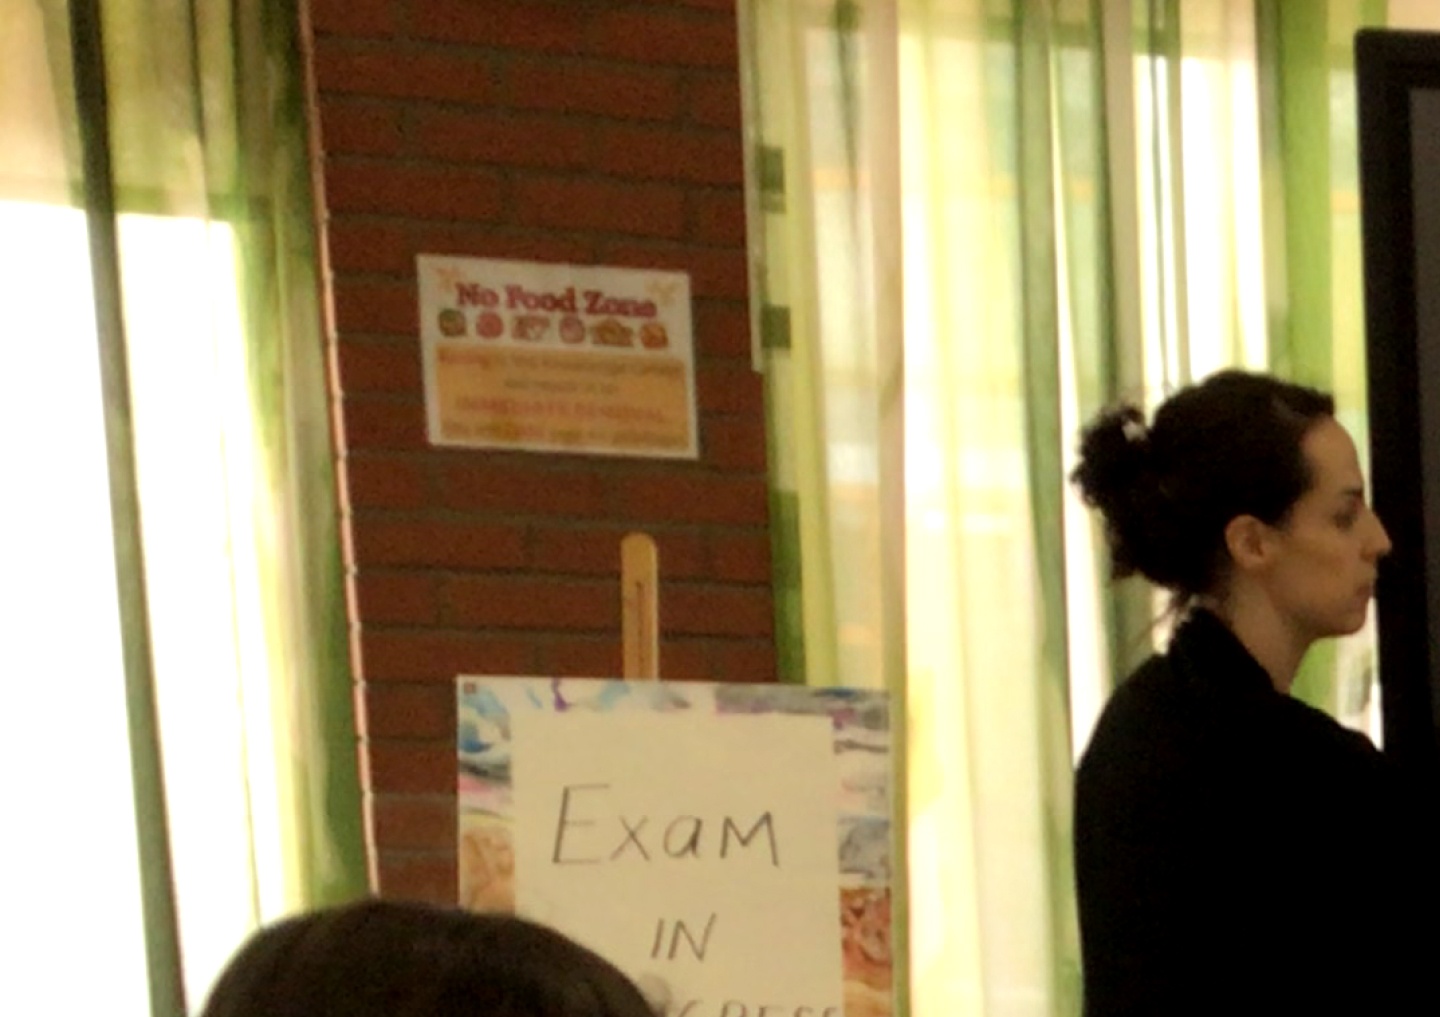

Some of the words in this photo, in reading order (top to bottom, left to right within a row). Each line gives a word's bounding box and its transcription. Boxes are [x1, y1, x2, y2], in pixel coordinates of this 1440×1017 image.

[455, 283, 500, 308] No
[505, 284, 578, 314] Food
[583, 291, 657, 317] Zone
[650, 912, 717, 963] IN
